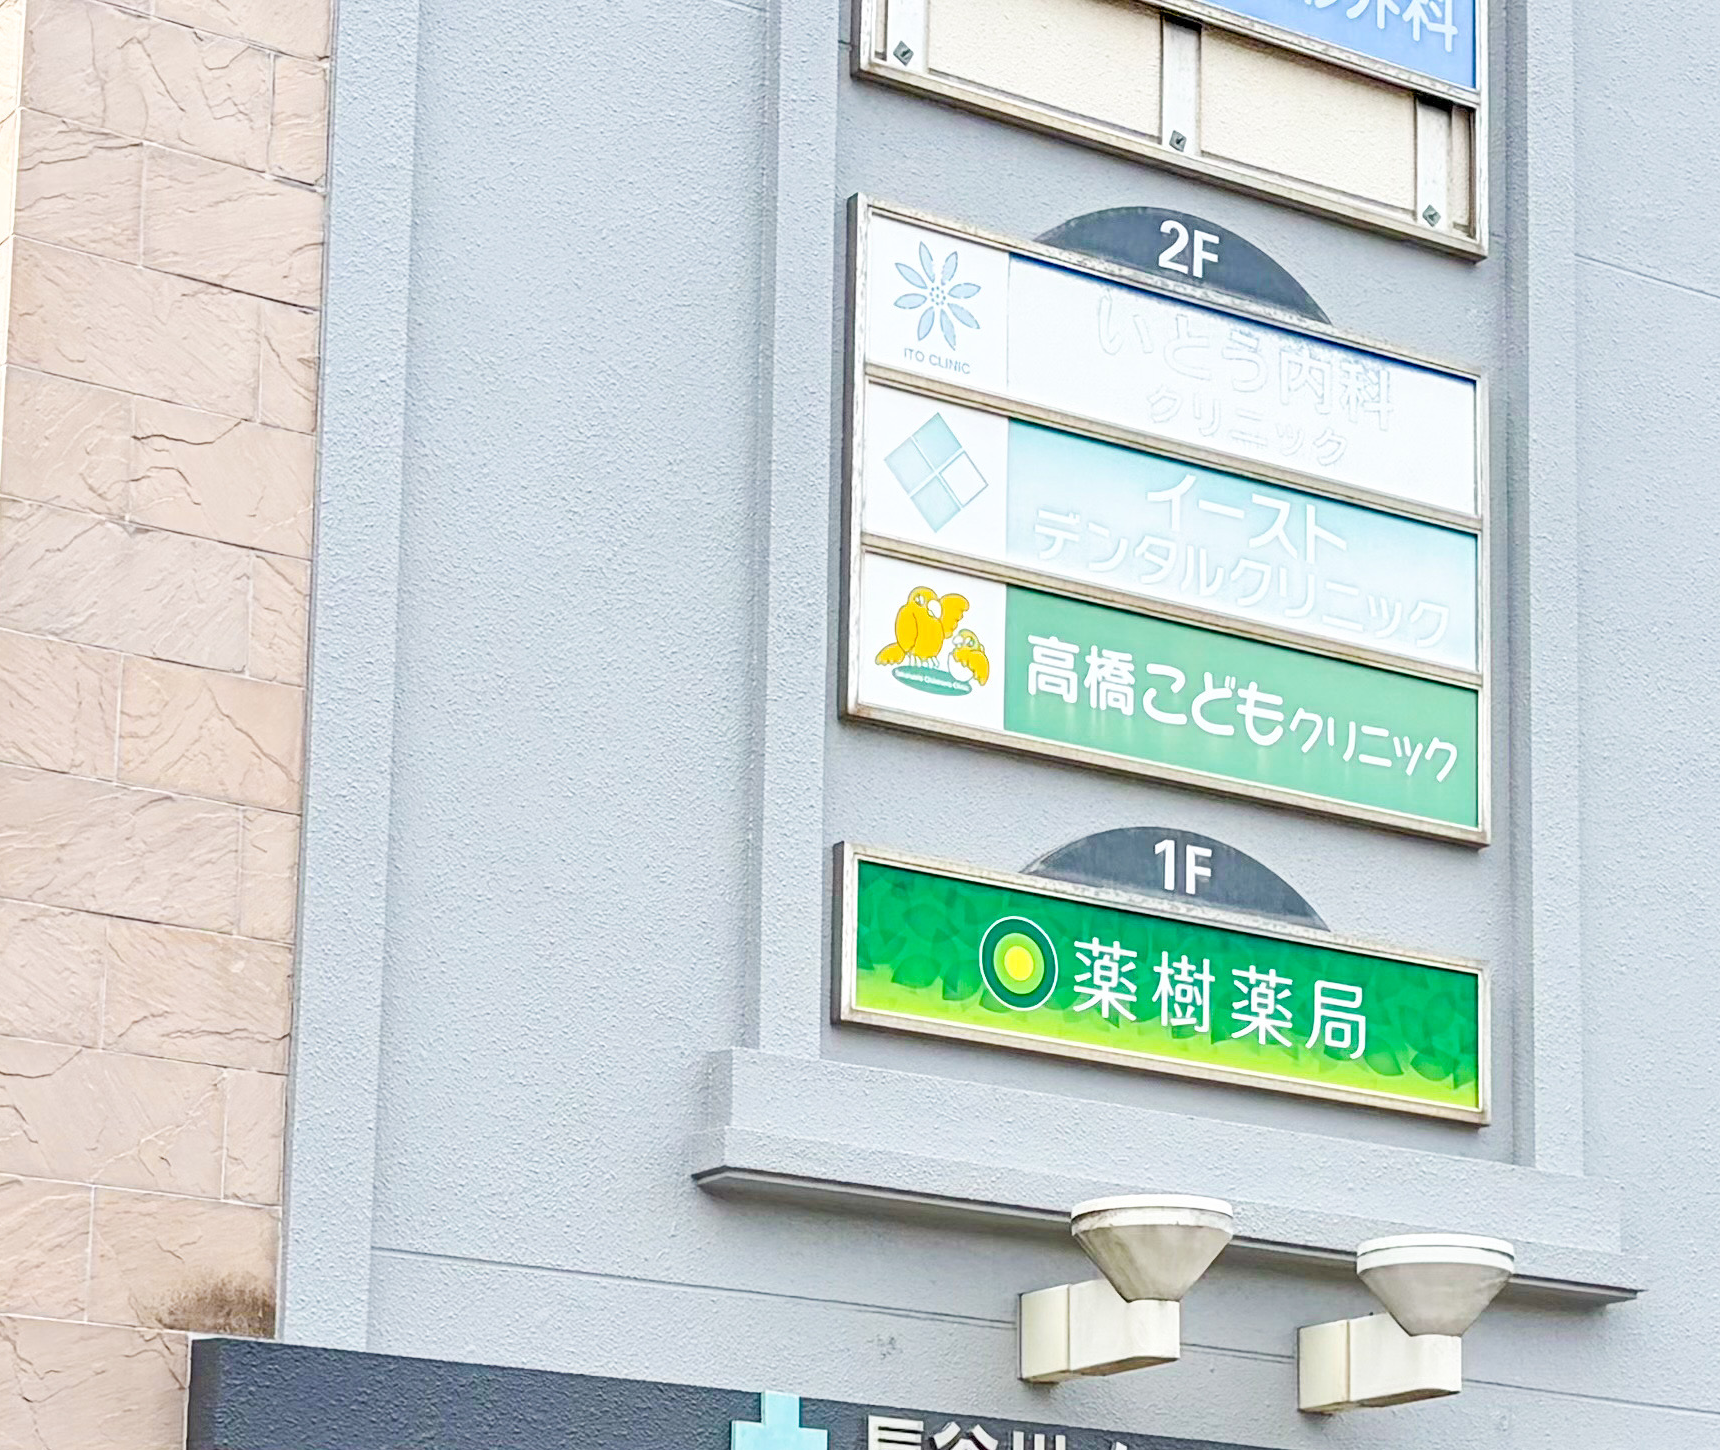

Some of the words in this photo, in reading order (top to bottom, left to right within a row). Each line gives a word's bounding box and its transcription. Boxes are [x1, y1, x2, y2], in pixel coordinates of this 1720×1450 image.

[1159, 220, 1219, 278] 2F
[904, 347, 925, 362] ITO
[929, 354, 970, 375] CLINIC
[1097, 285, 1396, 432] いとう内科
[1145, 385, 1348, 467] クリニック
[1145, 474, 1348, 564] イースト
[1032, 507, 1449, 648] デンタルクリニック
[1027, 634, 1459, 783] 高橋こどもクリニック
[1153, 838, 1213, 894] 1F
[1072, 936, 1367, 1060] 薬樹薬局
